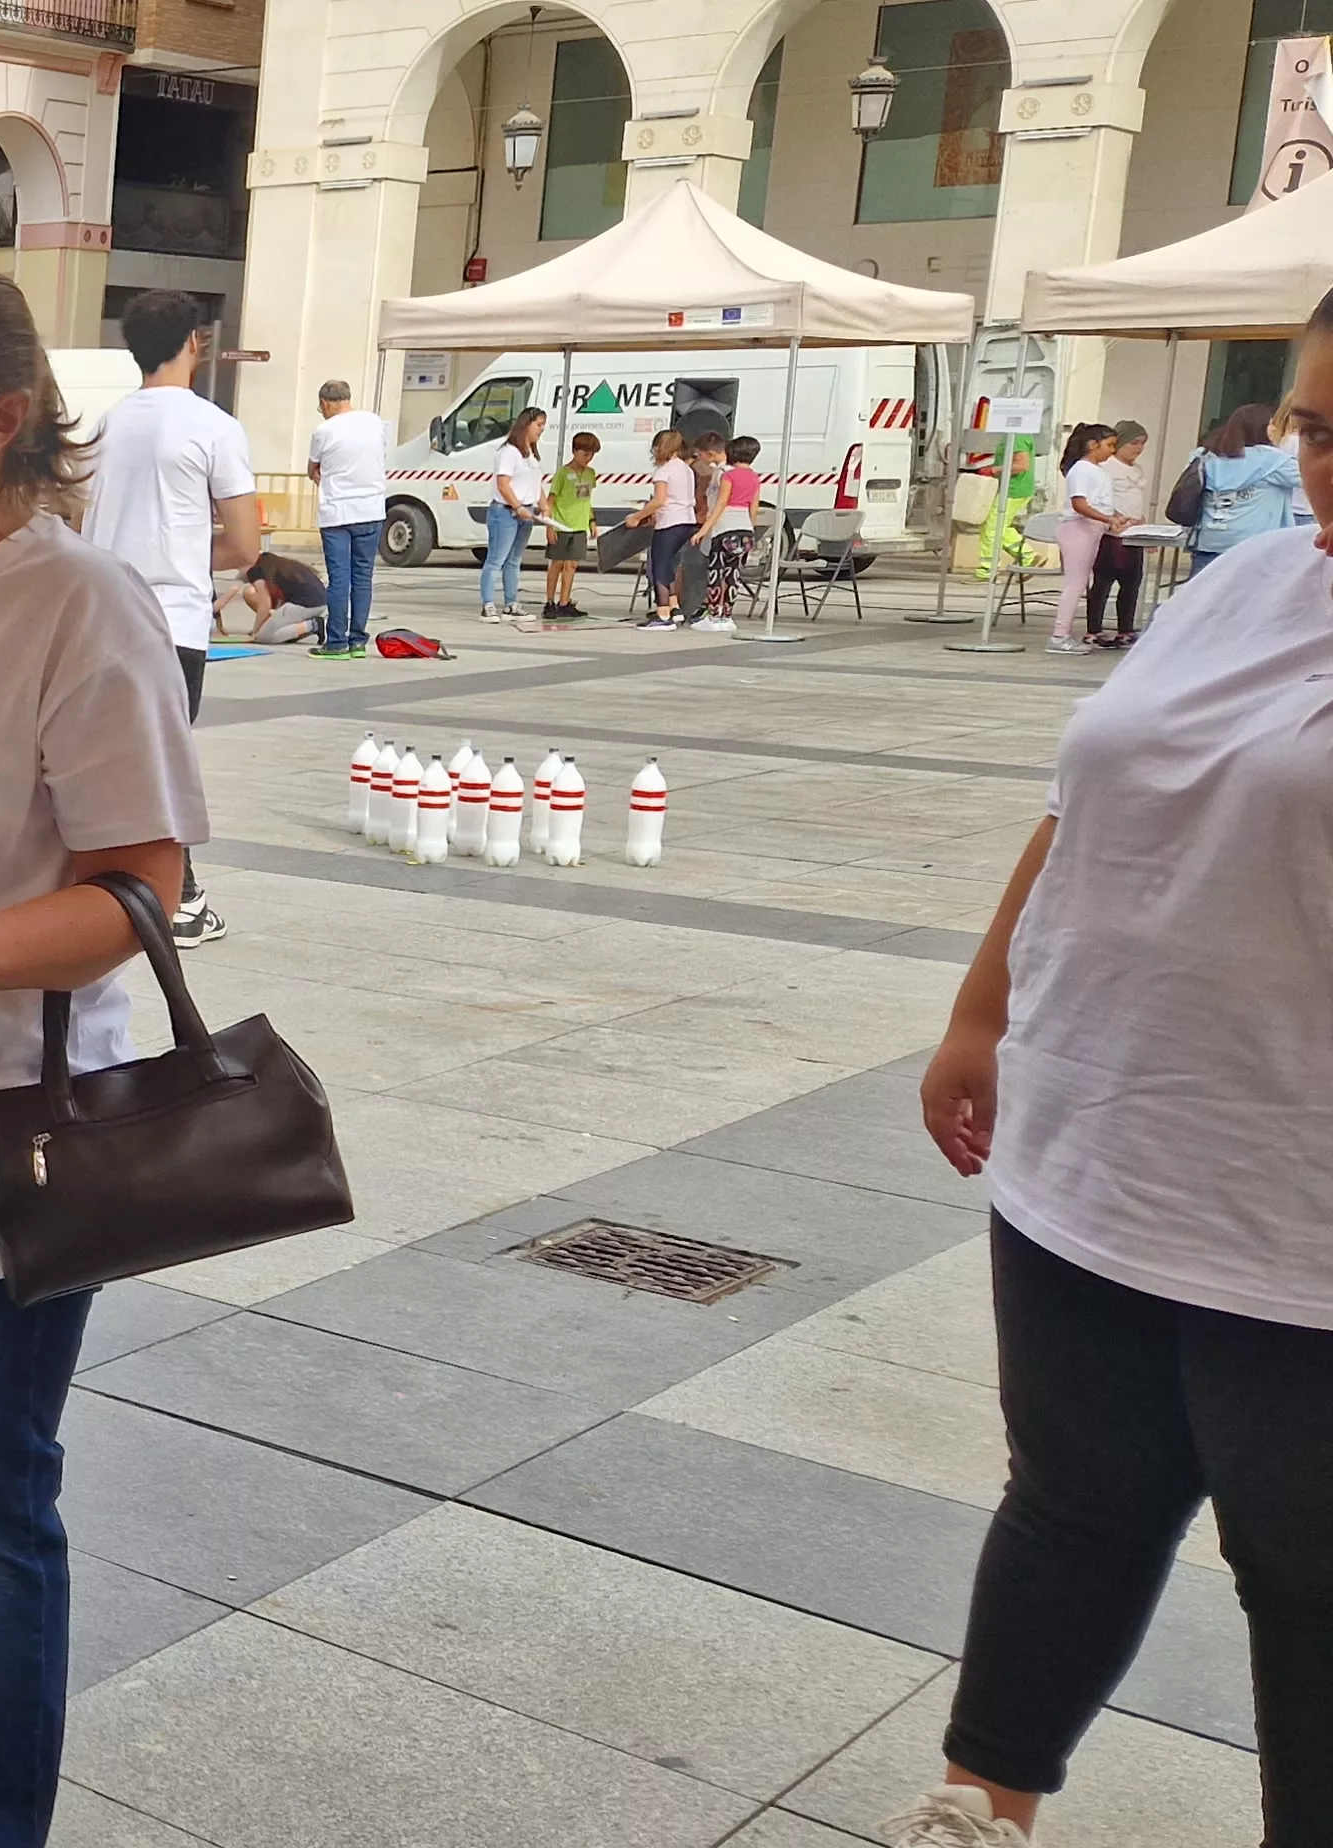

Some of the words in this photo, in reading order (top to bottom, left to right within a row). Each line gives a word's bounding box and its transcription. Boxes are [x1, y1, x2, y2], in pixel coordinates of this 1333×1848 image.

[155, 73, 216, 106] TATAU
[1281, 96, 1318, 113] Turis
[552, 379, 675, 413] PRAMES
